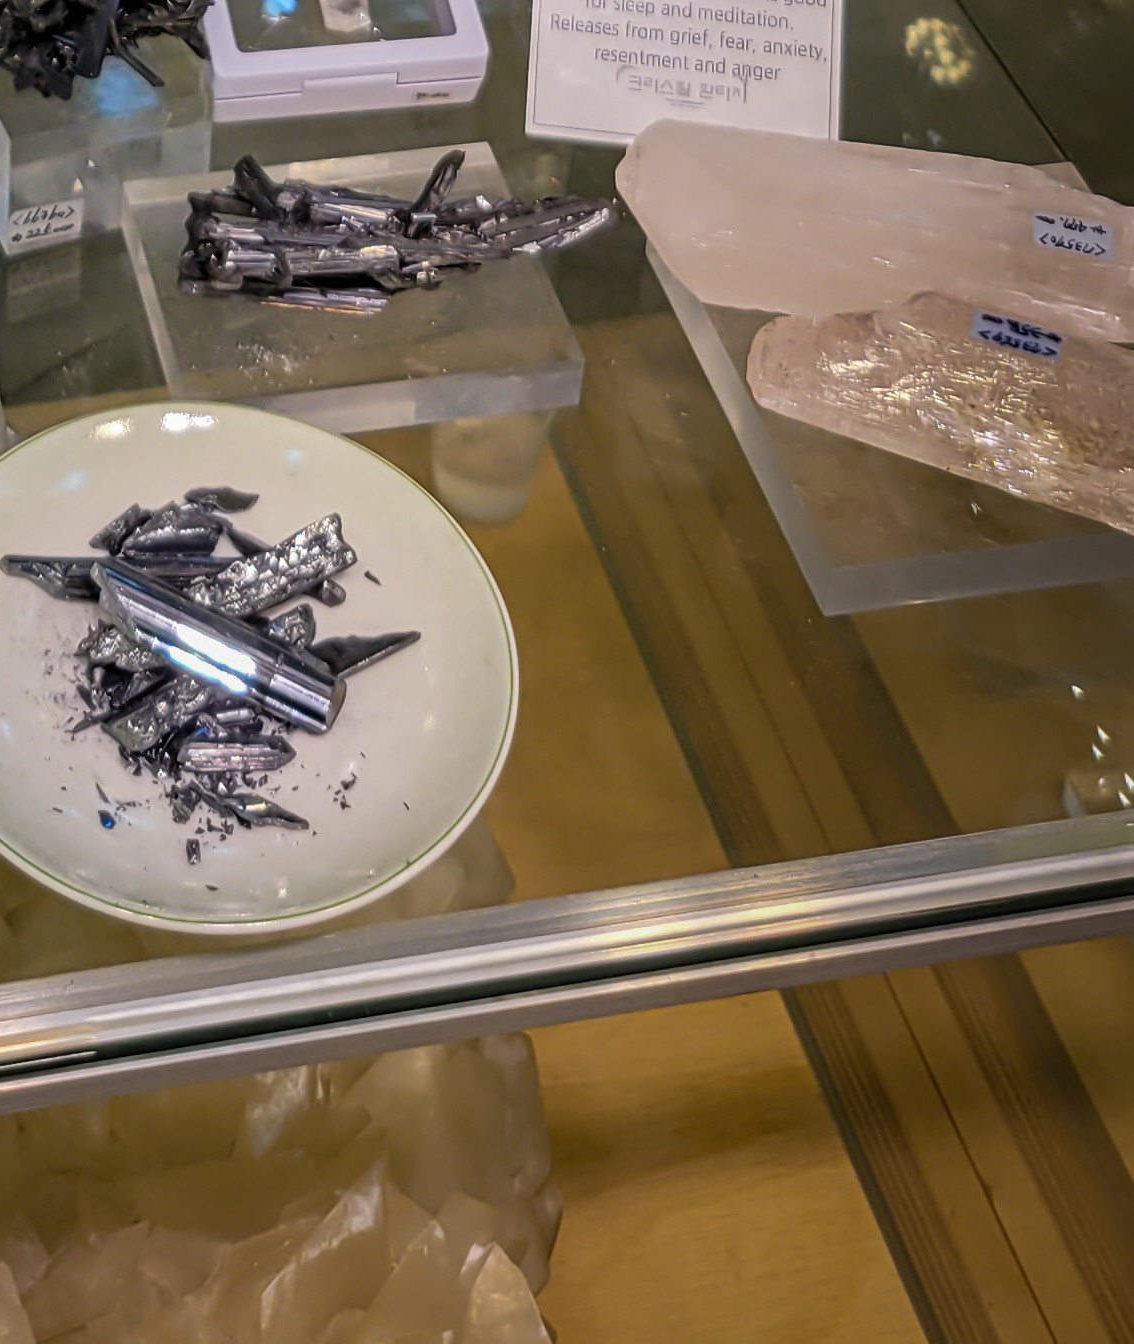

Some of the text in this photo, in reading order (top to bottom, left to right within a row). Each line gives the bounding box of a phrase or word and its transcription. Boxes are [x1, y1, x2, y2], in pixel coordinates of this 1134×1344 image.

[661, 0, 693, 19] and
[697, 4, 795, 32] meditation.
[550, 13, 829, 63] Releases from grief, fear, anxiety,
[594, 45, 783, 83] resentment and anger
